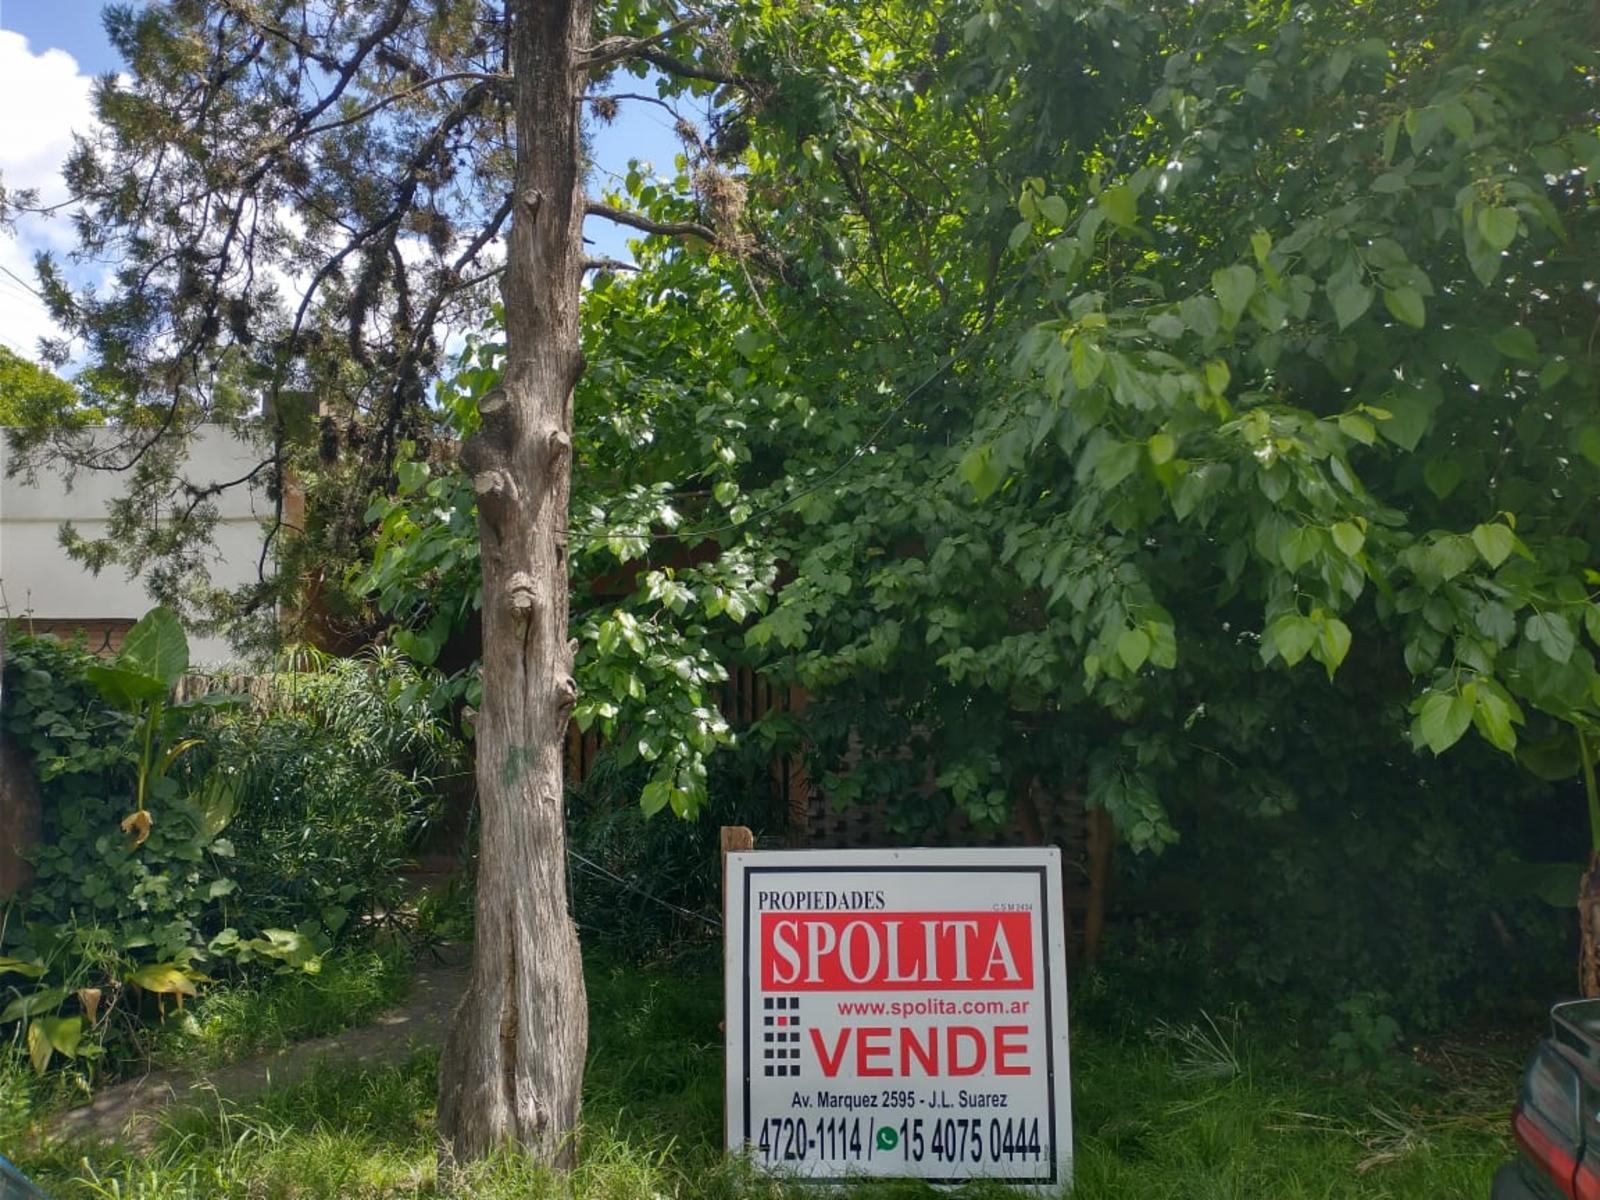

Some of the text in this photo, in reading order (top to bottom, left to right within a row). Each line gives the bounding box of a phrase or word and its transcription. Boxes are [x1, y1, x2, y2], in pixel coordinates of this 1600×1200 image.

[758, 891, 885, 910] PROPIEDADES
[772, 920, 1023, 984] SPOLITA
[838, 998, 1030, 1018] www.spolita.com.ar
[809, 1026, 1031, 1078] VENDE
[791, 1092, 813, 1108] Av.
[817, 1091, 878, 1111] Marquez
[882, 1091, 916, 1108] 2595
[929, 1091, 954, 1108] J.L.
[959, 1091, 1008, 1108] Suarez
[759, 1117, 862, 1161] 4720-1114
[901, 1118, 924, 1162] 15
[932, 1118, 983, 1162] 4075
[990, 1117, 1041, 1162] 0444
